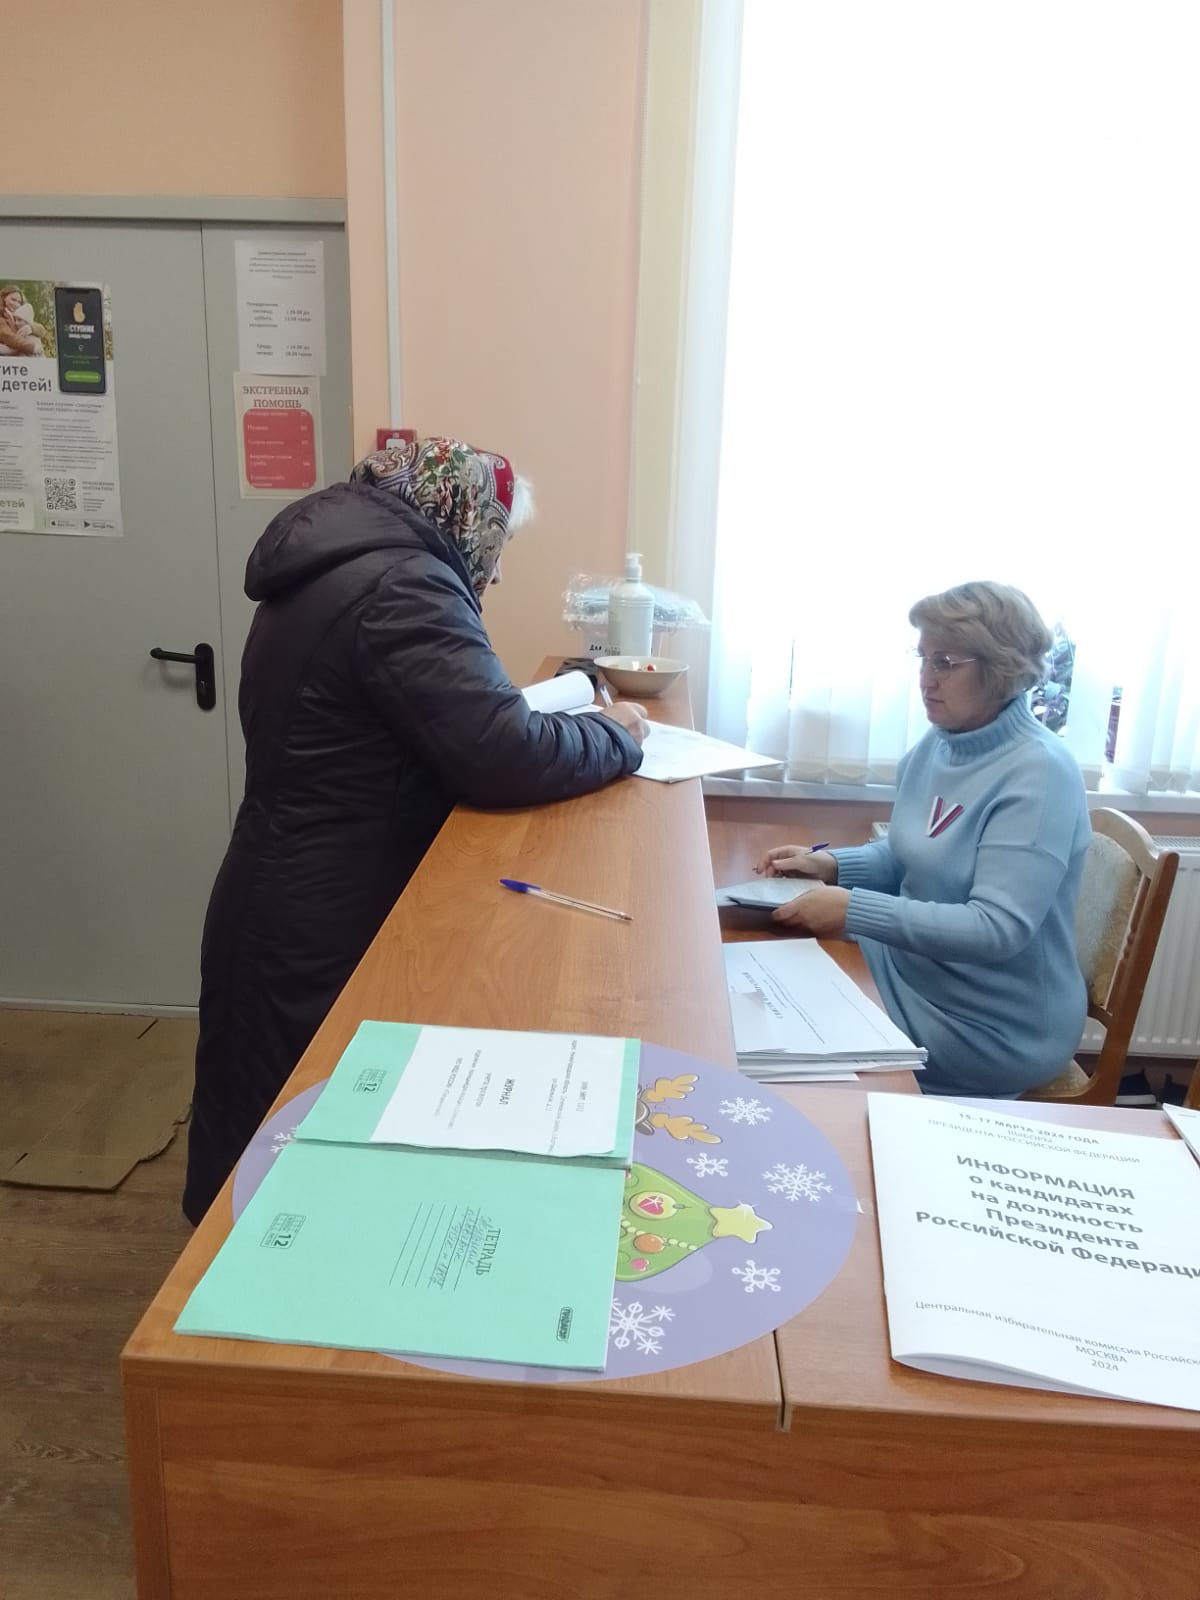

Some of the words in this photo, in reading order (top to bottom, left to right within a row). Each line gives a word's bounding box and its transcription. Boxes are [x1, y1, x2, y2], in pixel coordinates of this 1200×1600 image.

[0, 364, 29, 376] ите
[1, 377, 52, 392] детей!
[242, 385, 310, 395] ЭКСТРЕННАЯ
[253, 399, 302, 409] ПОМОЩЬ
[363, 1083, 378, 1093] 12
[499, 1078, 515, 1105] ЖУРНАЛ
[994, 1119, 1035, 1133] МАРТА
[1037, 1129, 1065, 1139] 2024
[1067, 1134, 1100, 1145] ГОДА
[997, 1134, 1071, 1153] РОССИЙСКОЙ
[1073, 1148, 1141, 1164] ФЕДЕРАЦИИ
[956, 1154, 1136, 1200] ИНФОРМАЦИЯ
[969, 1174, 983, 1184] о
[990, 1177, 1134, 1216] кандидатах
[970, 1189, 999, 1204] на
[1006, 1196, 1144, 1233] должность
[273, 1233, 292, 1247] 12
[915, 1210, 1065, 1255] Российской
[985, 1207, 1140, 1250] Президента
[476, 1227, 501, 1276] ТЕТРАДЬ
[915, 1300, 992, 1320] Центральная
[994, 1313, 1082, 1344] избирательная
[1084, 1337, 1142, 1357] комиссия
[1075, 1344, 1128, 1363] МОСКВА
[1091, 1358, 1119, 1372] 2024
